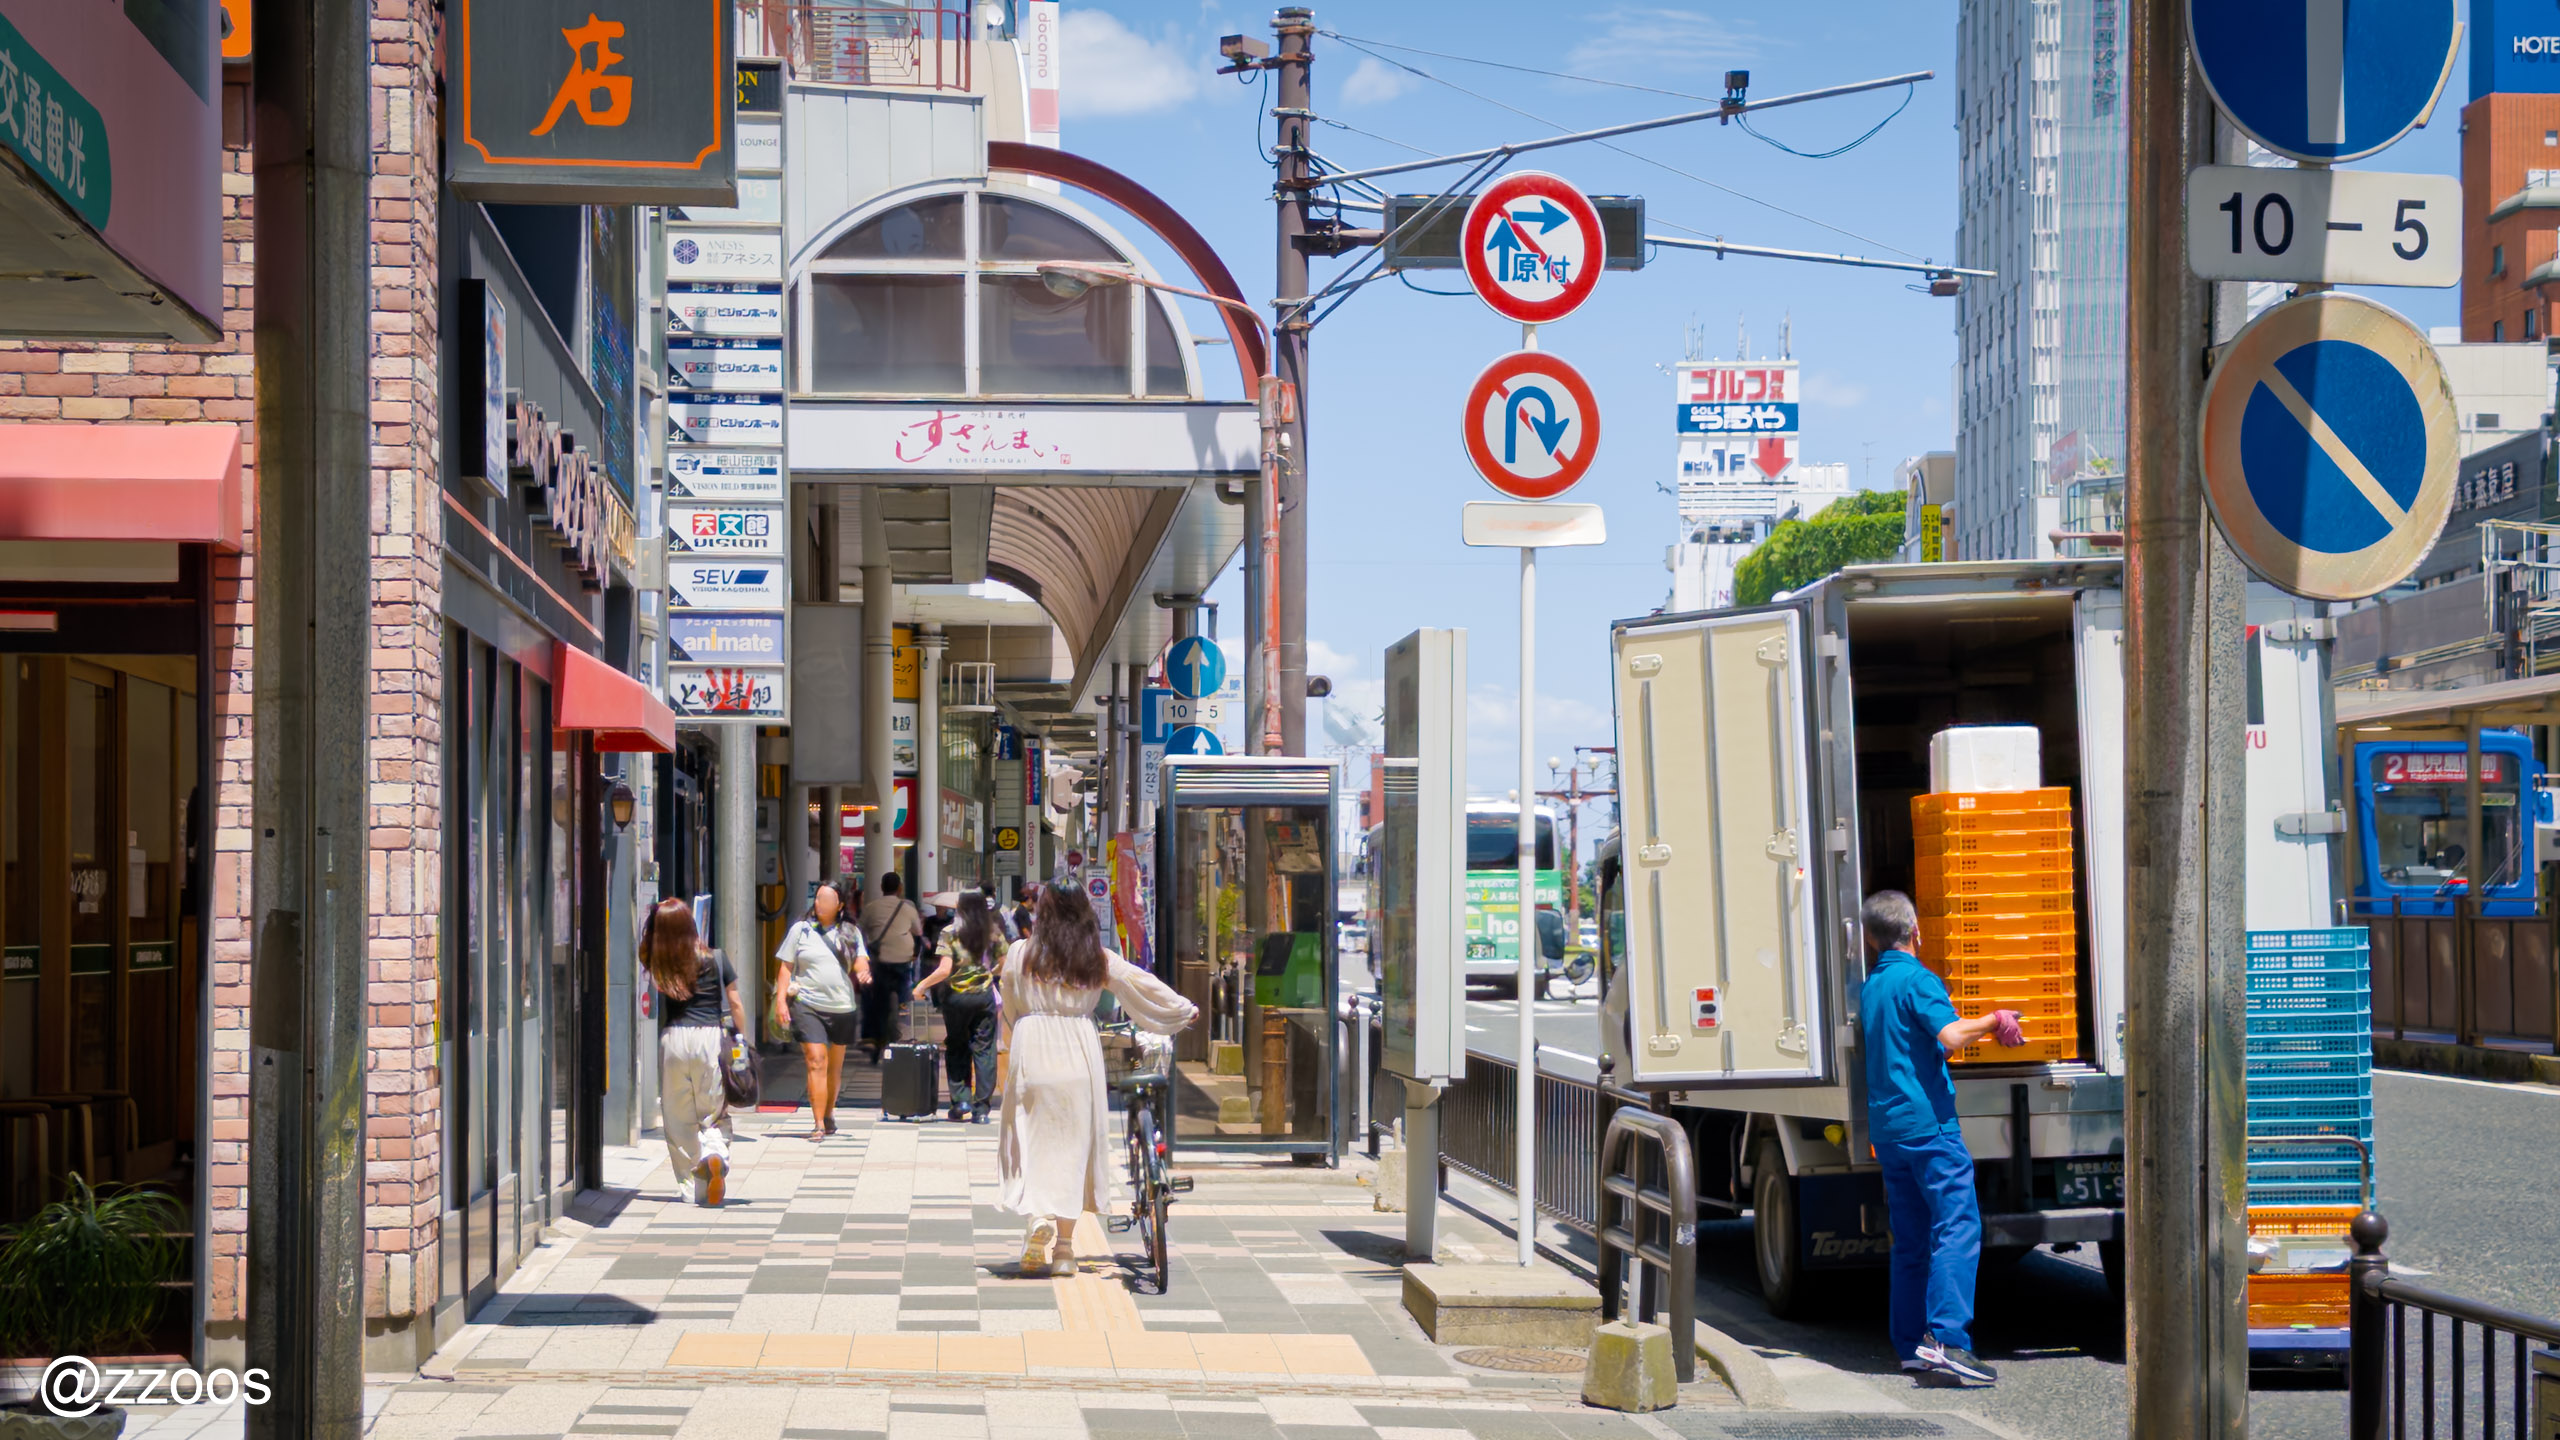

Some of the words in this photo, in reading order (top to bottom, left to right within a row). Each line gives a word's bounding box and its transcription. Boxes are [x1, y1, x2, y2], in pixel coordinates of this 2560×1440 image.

[1037, 13, 1051, 78] docomo
[530, 13, 633, 136] 店
[2219, 192, 2295, 256] 10
[2392, 199, 2429, 261] 5
[721, 252, 774, 265] アネシス
[1512, 253, 1571, 284] 原付
[1691, 406, 1721, 415] GOLF
[693, 514, 769, 536] 天文館
[691, 569, 735, 585] SEV
[683, 627, 774, 652] animate
[1170, 705, 1188, 718] 10
[1209, 705, 1218, 718] 5
[2386, 754, 2404, 780] 2
[1028, 822, 1036, 866] docomo
